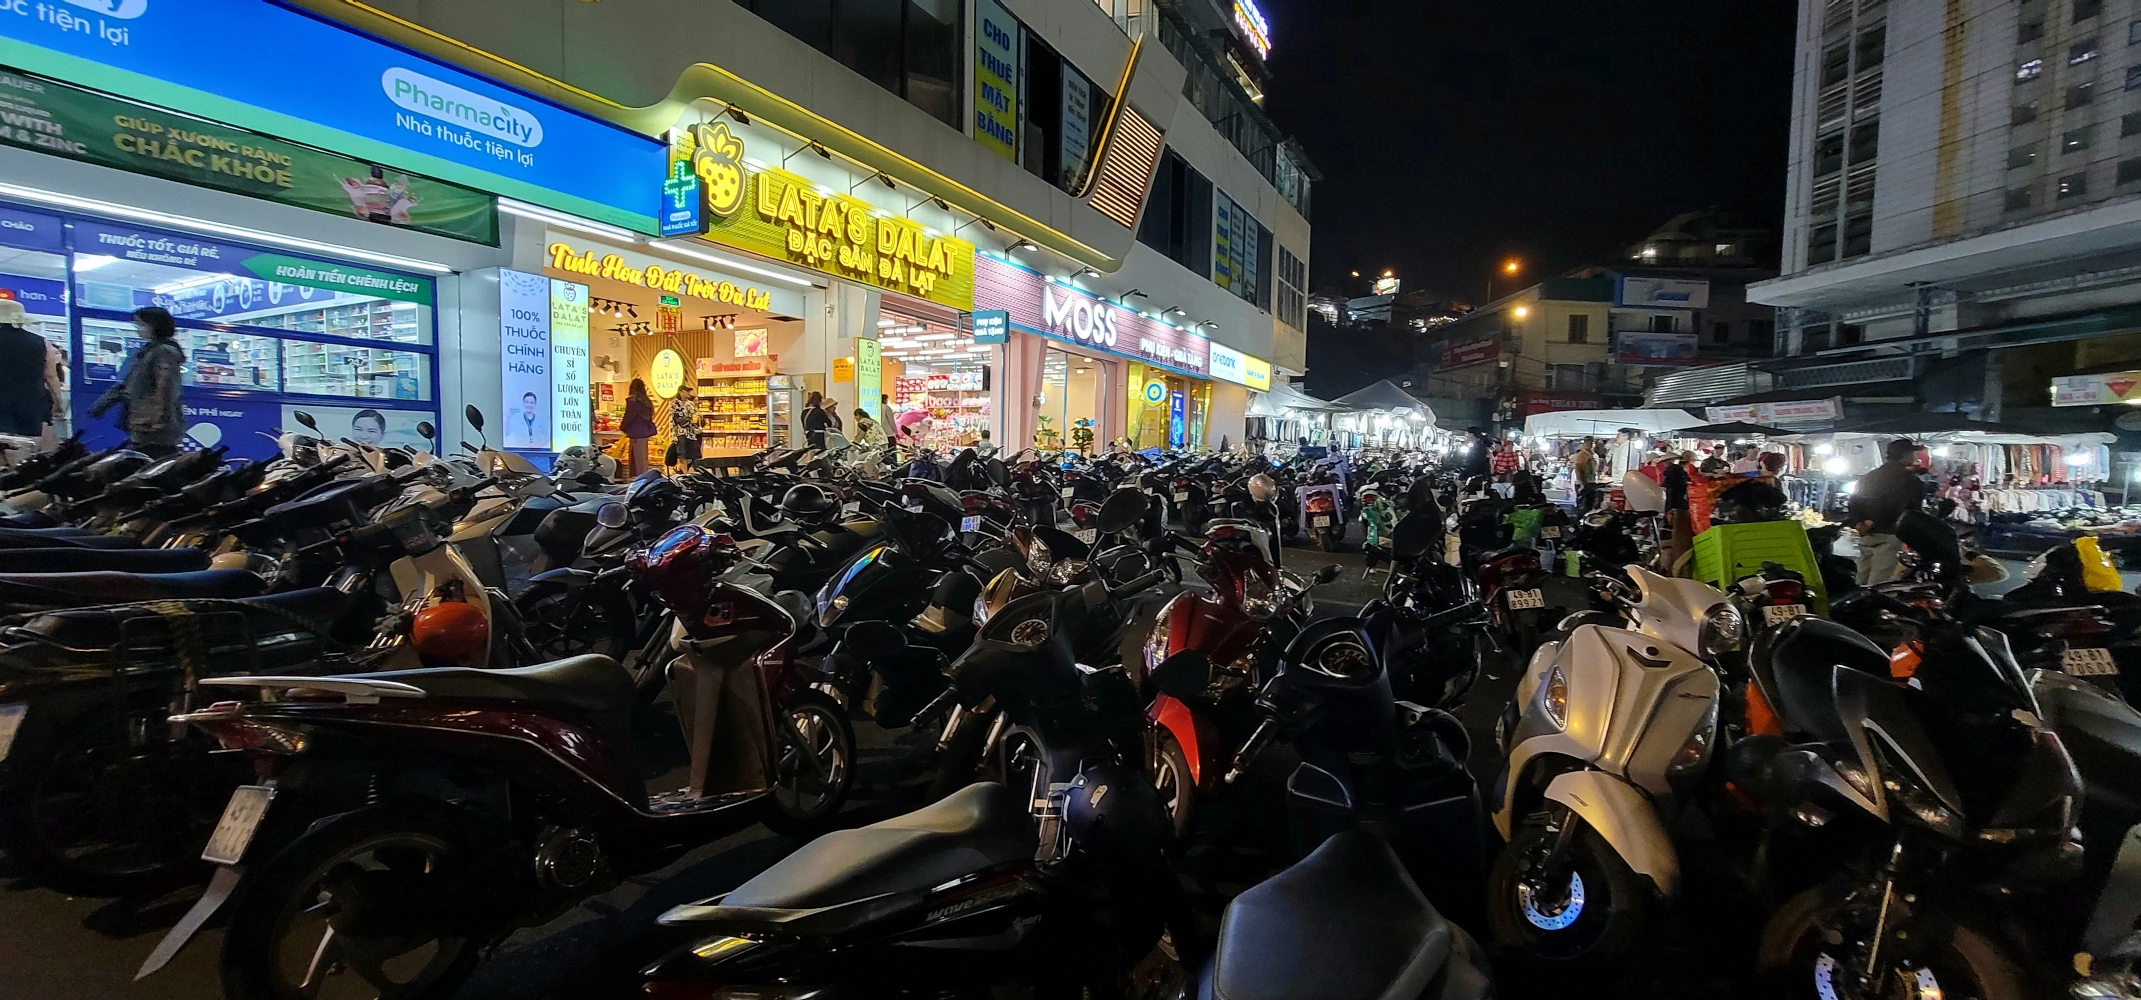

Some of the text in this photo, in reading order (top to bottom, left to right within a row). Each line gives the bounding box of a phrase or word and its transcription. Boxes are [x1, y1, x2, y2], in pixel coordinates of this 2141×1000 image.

[36, 2, 90, 34] tiện
[100, 19, 128, 46] lợi
[984, 18, 1010, 51] CHO
[980, 47, 1012, 85] THUÊ
[982, 81, 1010, 114] MẶT
[394, 78, 533, 143] Pharmacity
[114, 115, 164, 134] GIÚP
[167, 127, 238, 154] XƯƠNG
[396, 112, 534, 167] Nhà thuốc tiện lợi
[978, 111, 1013, 147] BẰNG
[34, 132, 88, 154] ZINC
[113, 133, 294, 188] CHẮC KHỎE
[757, 172, 958, 276] LATA'S DALAT
[99, 233, 145, 249] THUỐC
[148, 238, 175, 253] TỐT,
[177, 244, 199, 255] GIÁ
[126, 249, 147, 260] NẾU
[149, 251, 183, 264] KHÔNG
[788, 228, 936, 295] ĐẶC SẢN ĐÀ LẠT
[276, 265, 419, 293] HOÀN TIỀN CHÊNH LỆCH
[601, 254, 644, 285] Hoa
[645, 265, 684, 293] Đất
[684, 273, 718, 300] Trời
[718, 281, 744, 305] Đà
[745, 287, 770, 313] Lạt
[511, 309, 540, 322] 100%
[552, 302, 587, 314] LATA'S
[554, 312, 586, 323] DALAT
[1044, 284, 1117, 348] MOSS
[505, 325, 546, 340] THUỐC
[507, 344, 544, 357] CHÍNH
[554, 345, 586, 357] CHUYÊN
[509, 361, 544, 375] HÃNG
[860, 358, 880, 366] LATA'S
[566, 370, 576, 380] SỐ
[557, 384, 584, 394] LƯỢNG
[200, 407, 218, 416] PHÍ
[564, 396, 579, 406] LỚN
[561, 409, 581, 419] TOÀN
[561, 421, 582, 431] QUỐC
